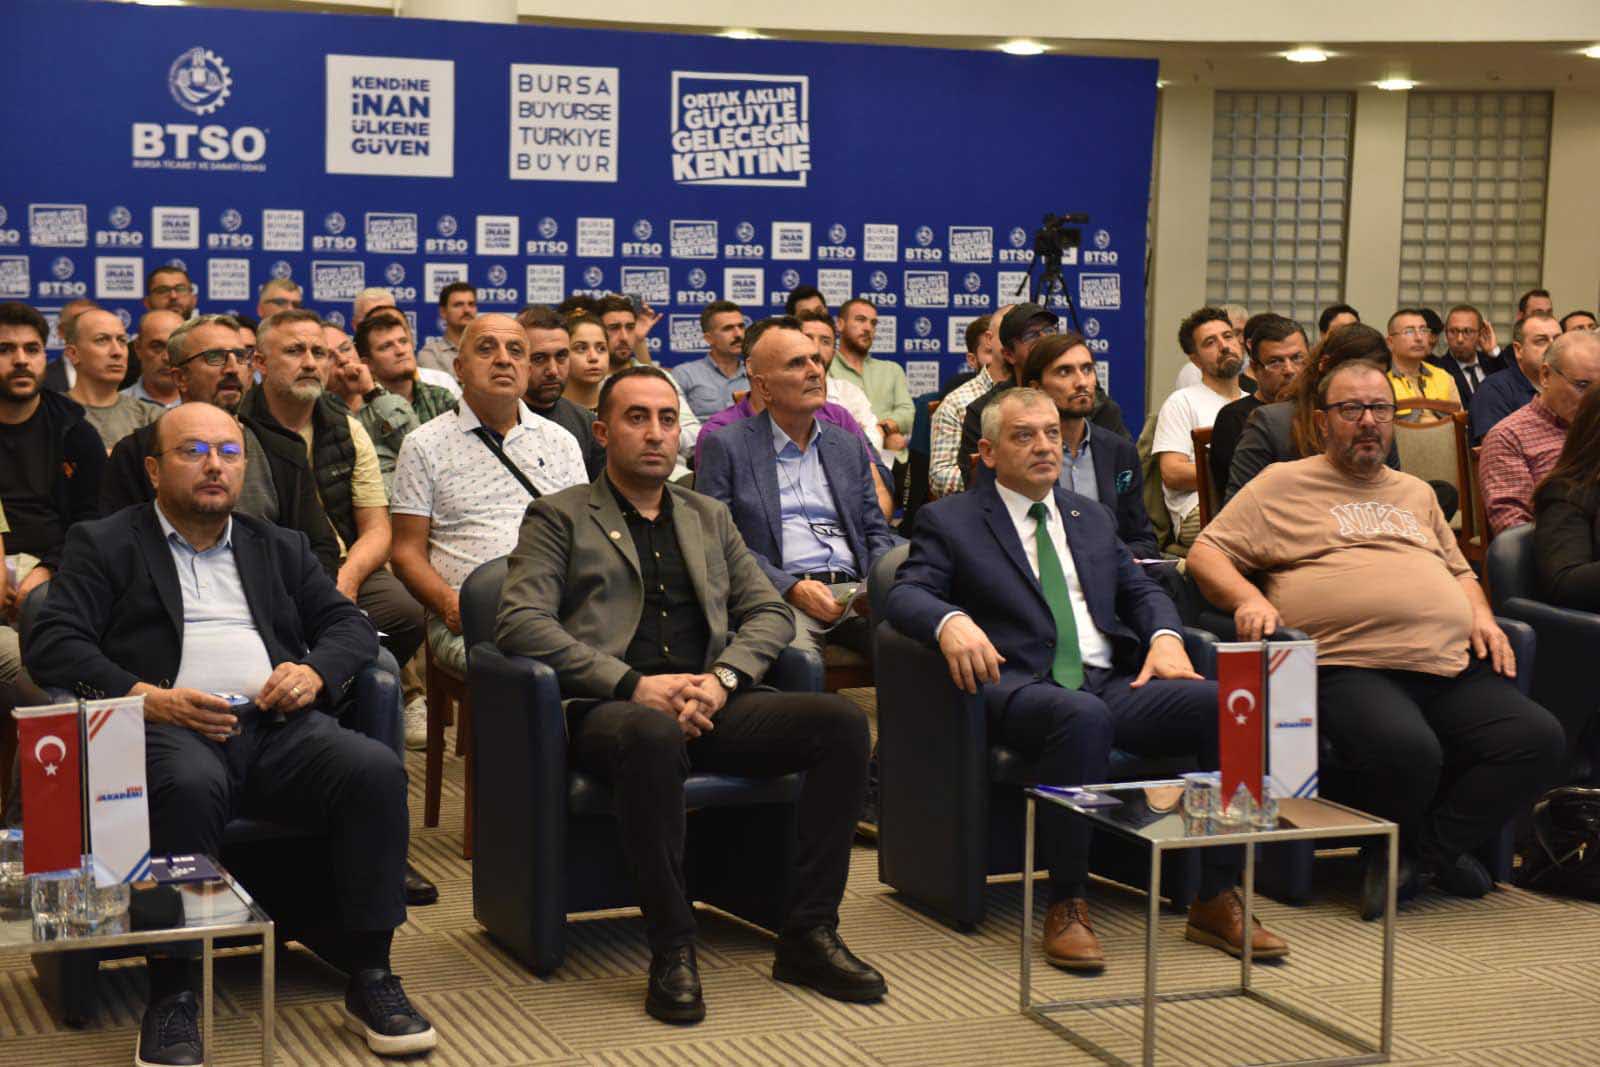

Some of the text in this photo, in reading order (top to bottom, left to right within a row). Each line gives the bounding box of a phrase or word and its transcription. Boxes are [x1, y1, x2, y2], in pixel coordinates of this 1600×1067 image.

[518, 73, 610, 96] BURSA
[682, 87, 796, 109] ORTAK AKLIN
[518, 99, 611, 121] BÜYÜRSE
[352, 119, 430, 136] ÜLKENE
[132, 122, 266, 162] BTSO
[517, 125, 610, 148] TÜRKİYE
[352, 137, 430, 156] GÜVEN
[517, 152, 610, 172] BÜYÜR
[0, 230, 21, 243] SO
[96, 231, 143, 245] BTSO
[208, 234, 253, 247] BTSO
[312, 236, 356, 249] BTSO
[426, 239, 468, 252] BTSO
[527, 241, 568, 254] BTSO
[622, 243, 662, 256] BTSO
[725, 245, 764, 257] BTSO
[818, 246, 856, 259] BTSO
[905, 248, 942, 260] BTSO
[999, 249, 1035, 262] BTSO
[1084, 251, 1118, 263] BTSO
[39, 281, 87, 296] BTSO
[476, 288, 518, 301] BTSO
[678, 290, 716, 303] BTSO
[771, 292, 790, 304] BT
[954, 293, 989, 306] BTSO
[904, 339, 941, 351] BTSO
[1329, 501, 1428, 543] NIKE
